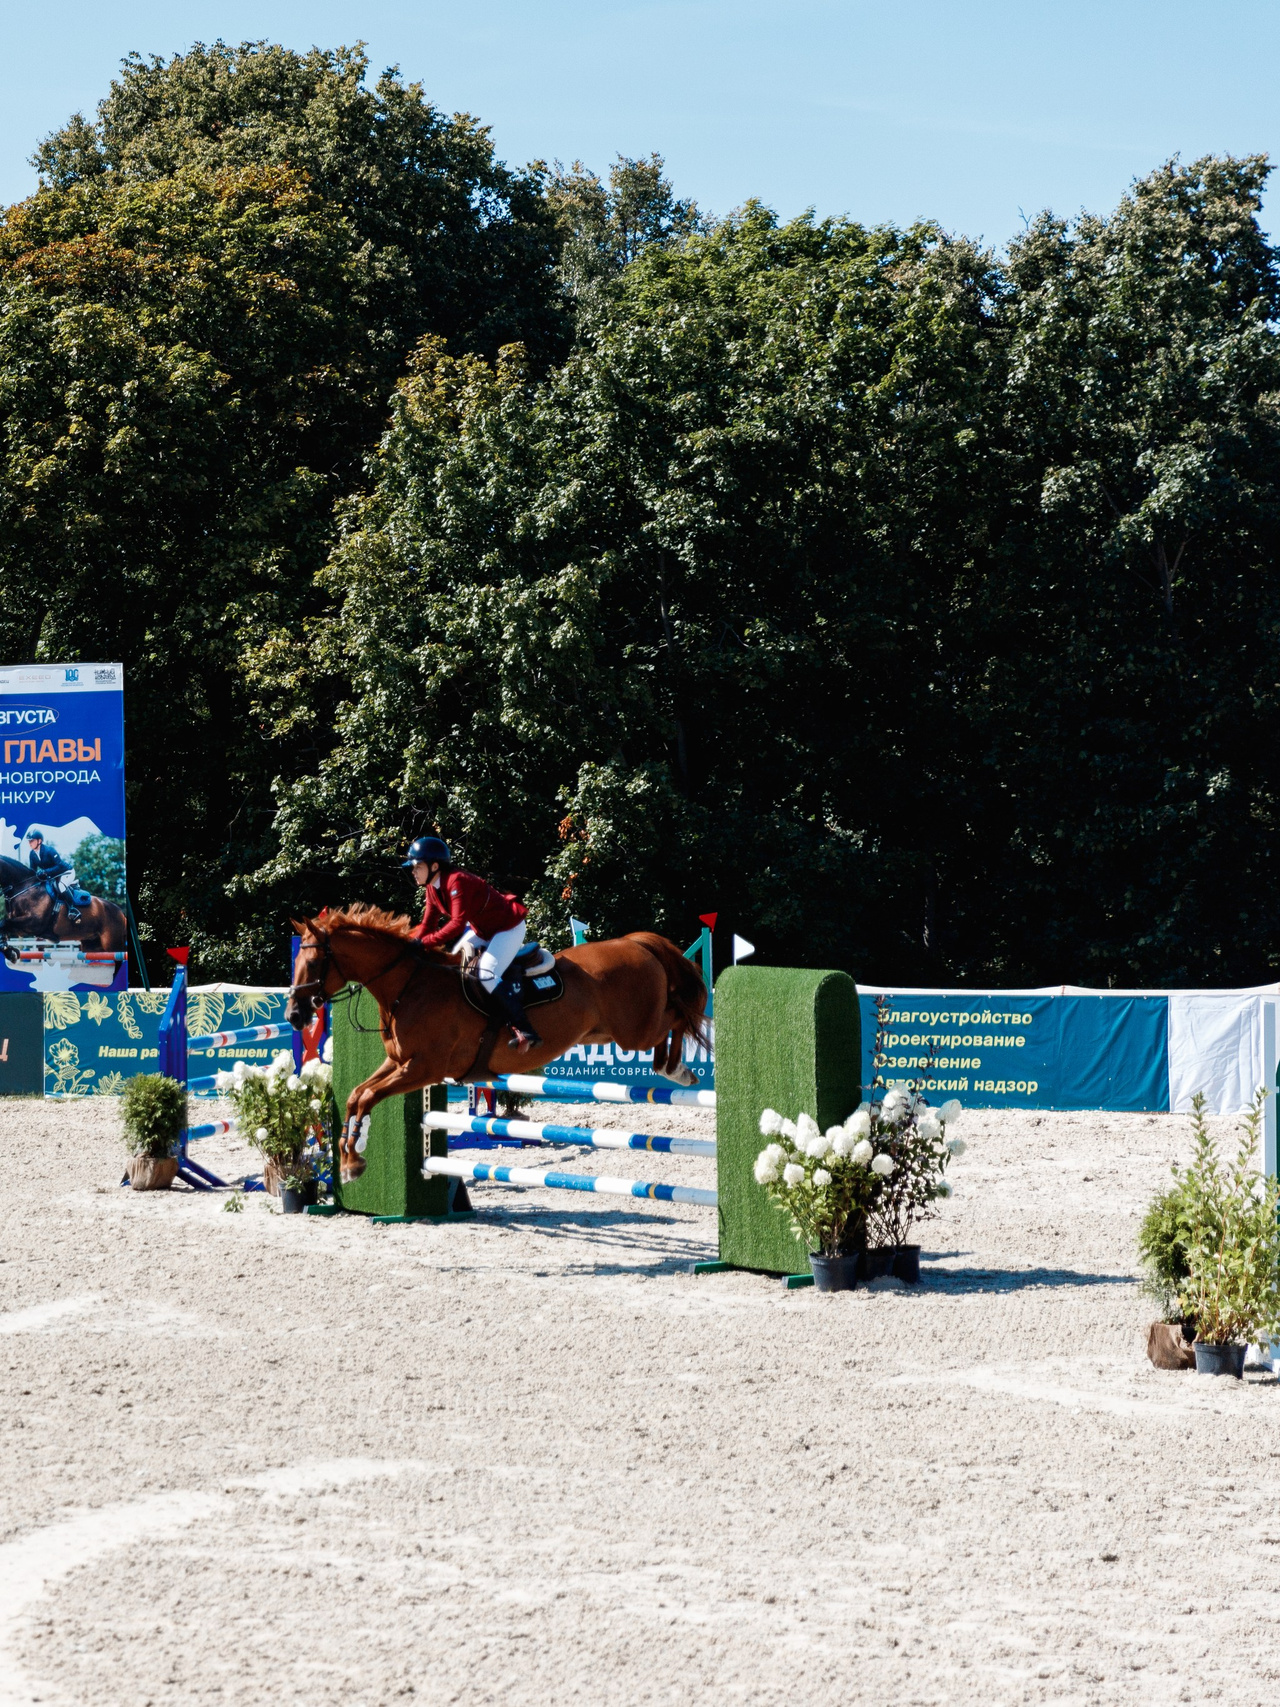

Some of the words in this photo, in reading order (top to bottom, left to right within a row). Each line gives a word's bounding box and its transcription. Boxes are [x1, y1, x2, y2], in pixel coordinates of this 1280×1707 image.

[4, 737, 101, 764] ГЛАВЫ
[0, 769, 101, 785] НОВГОРОДА
[98, 1045, 138, 1058] Наша
[206, 1047, 215, 1058] о
[218, 1047, 268, 1058] вашем
[543, 1066, 606, 1077] СОЗДАНИЕ
[973, 1078, 1038, 1095] надзор
